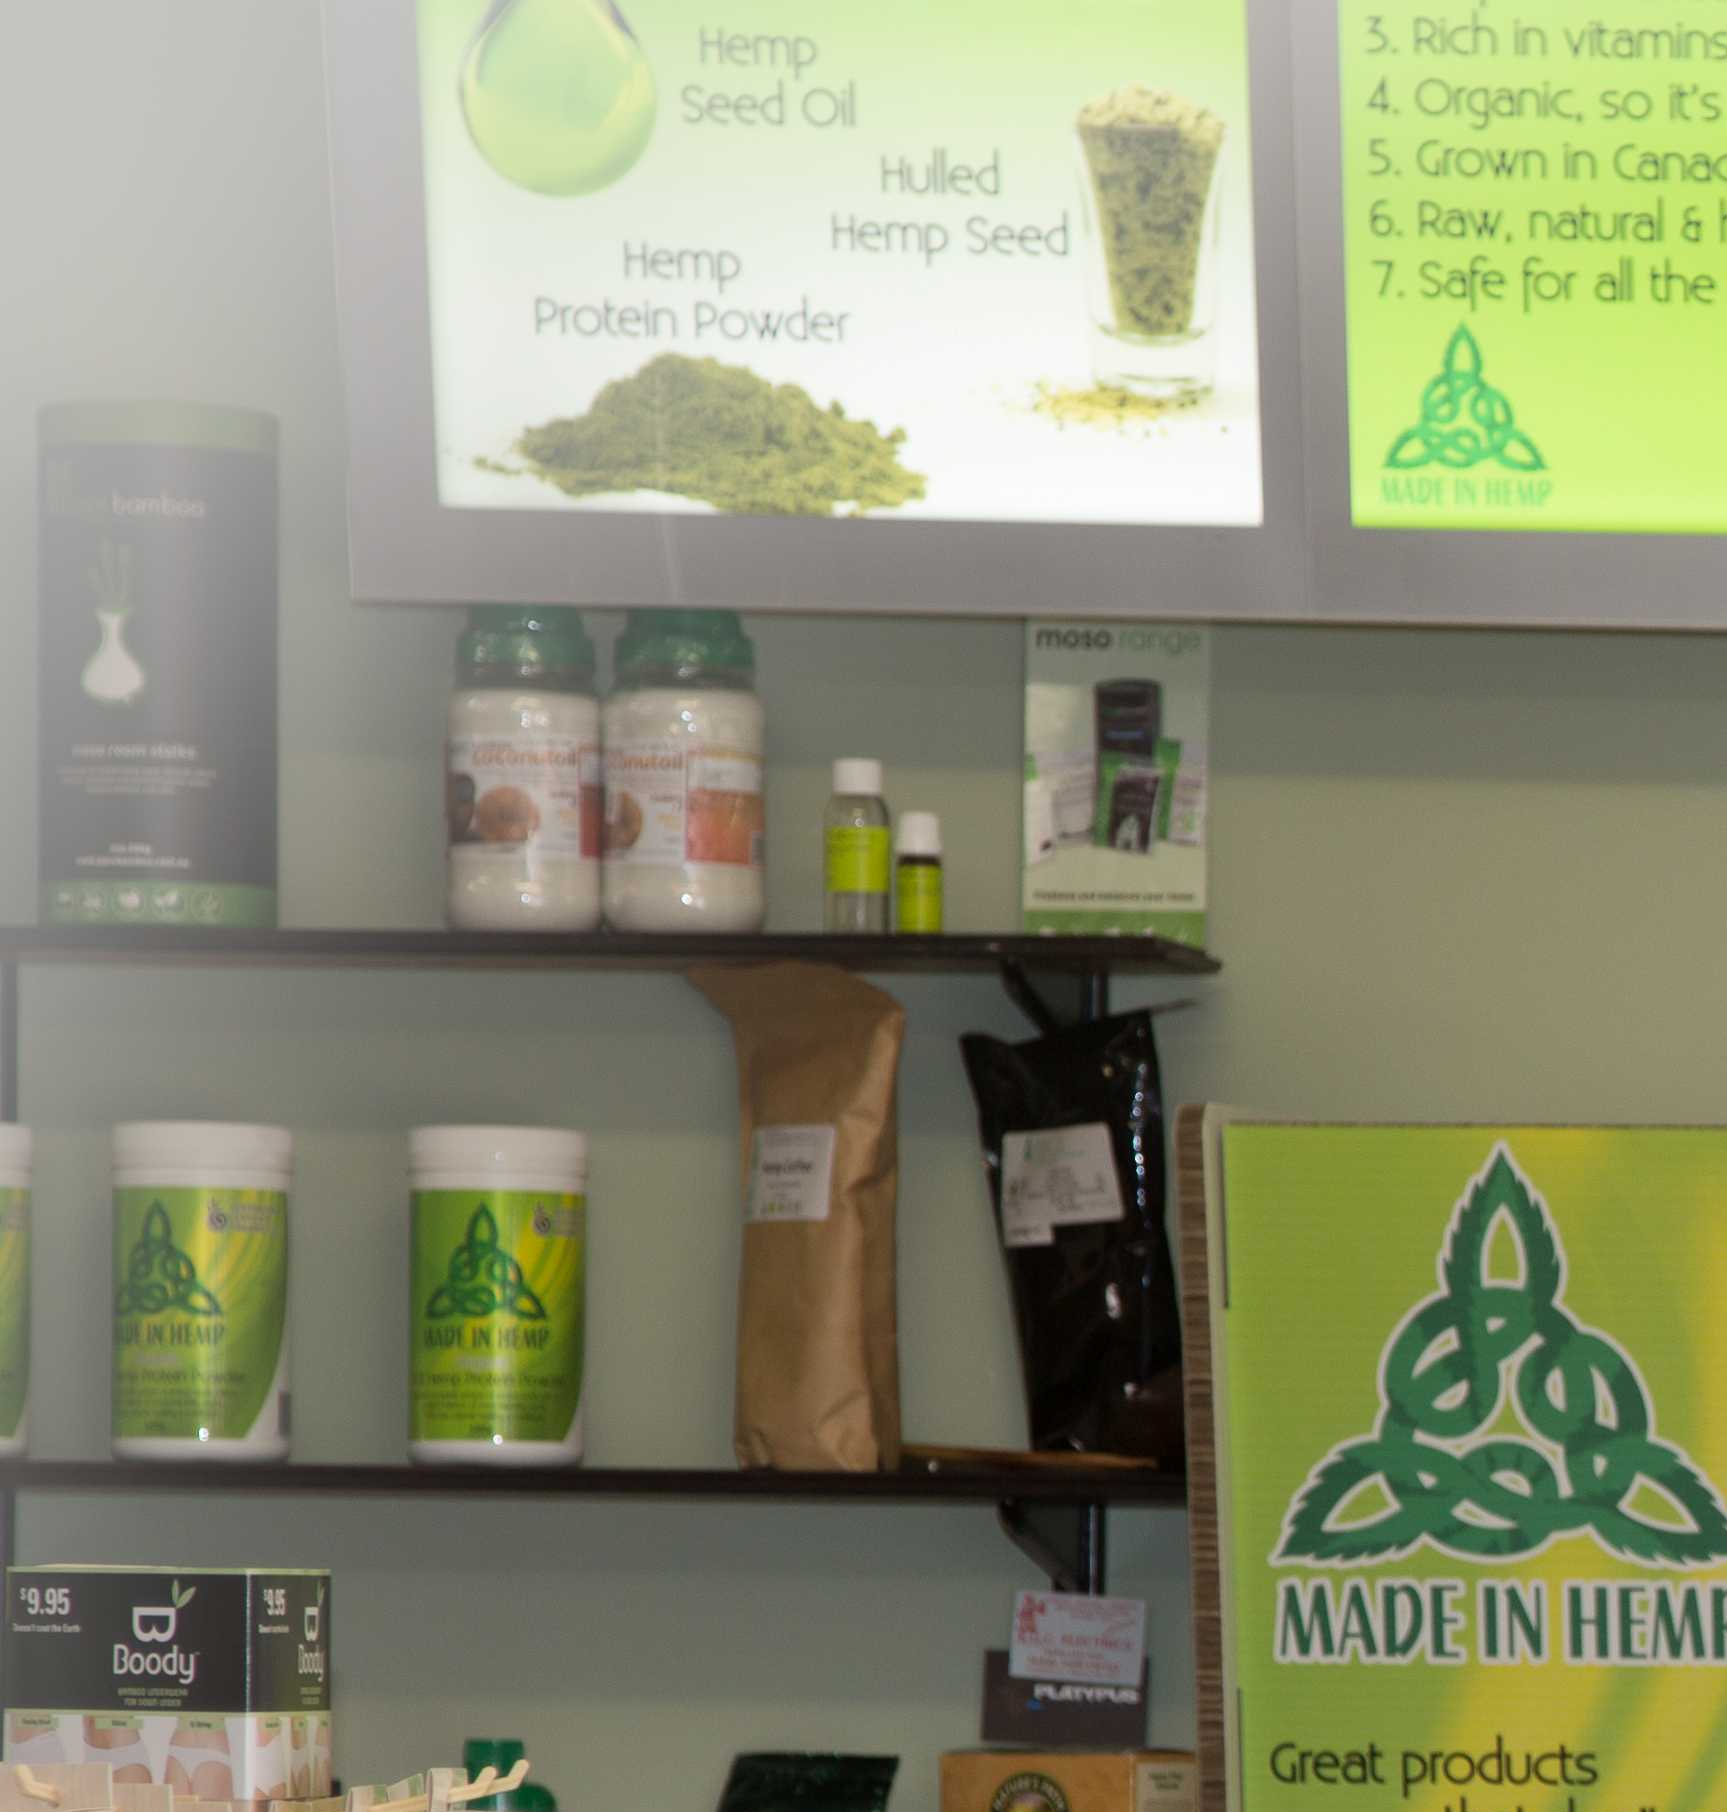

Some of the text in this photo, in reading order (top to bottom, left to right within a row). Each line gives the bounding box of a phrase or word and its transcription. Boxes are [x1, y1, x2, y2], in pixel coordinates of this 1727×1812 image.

[699, 27, 818, 74] Hemp
[1363, 15, 1398, 56] 3.
[1413, 14, 1497, 58] Rich
[1513, 15, 1546, 58] in
[681, 81, 857, 129] Seed Oil
[1367, 79, 1400, 116] 4.
[1413, 76, 1583, 130] Organic,
[1600, 88, 1652, 121] so
[1668, 82, 1722, 123] it's
[880, 148, 1000, 195] Hulled
[1368, 139, 1402, 177] 5.
[1416, 137, 1546, 181] Grown
[1564, 139, 1597, 181] in
[830, 213, 1068, 264] Hemp Seed
[1369, 200, 1404, 238] 6.
[1417, 200, 1512, 243] Raw,
[1529, 199, 1662, 245] natural
[1682, 210, 1702, 246] &
[623, 243, 741, 293] Hemp
[1370, 260, 1404, 299] 7.
[1418, 255, 1505, 311] Safe
[1522, 255, 1576, 313] for
[1594, 257, 1633, 302] all
[1650, 258, 1717, 307] the
[534, 295, 848, 343] Protein Powder
[1036, 627, 1112, 650] moso
[20, 1587, 70, 1616] $9.95
[1277, 1580, 1463, 1662] MADE
[1484, 1582, 1548, 1662] IN
[113, 1644, 197, 1684] Boody
[1270, 1735, 1598, 1796] Great products
